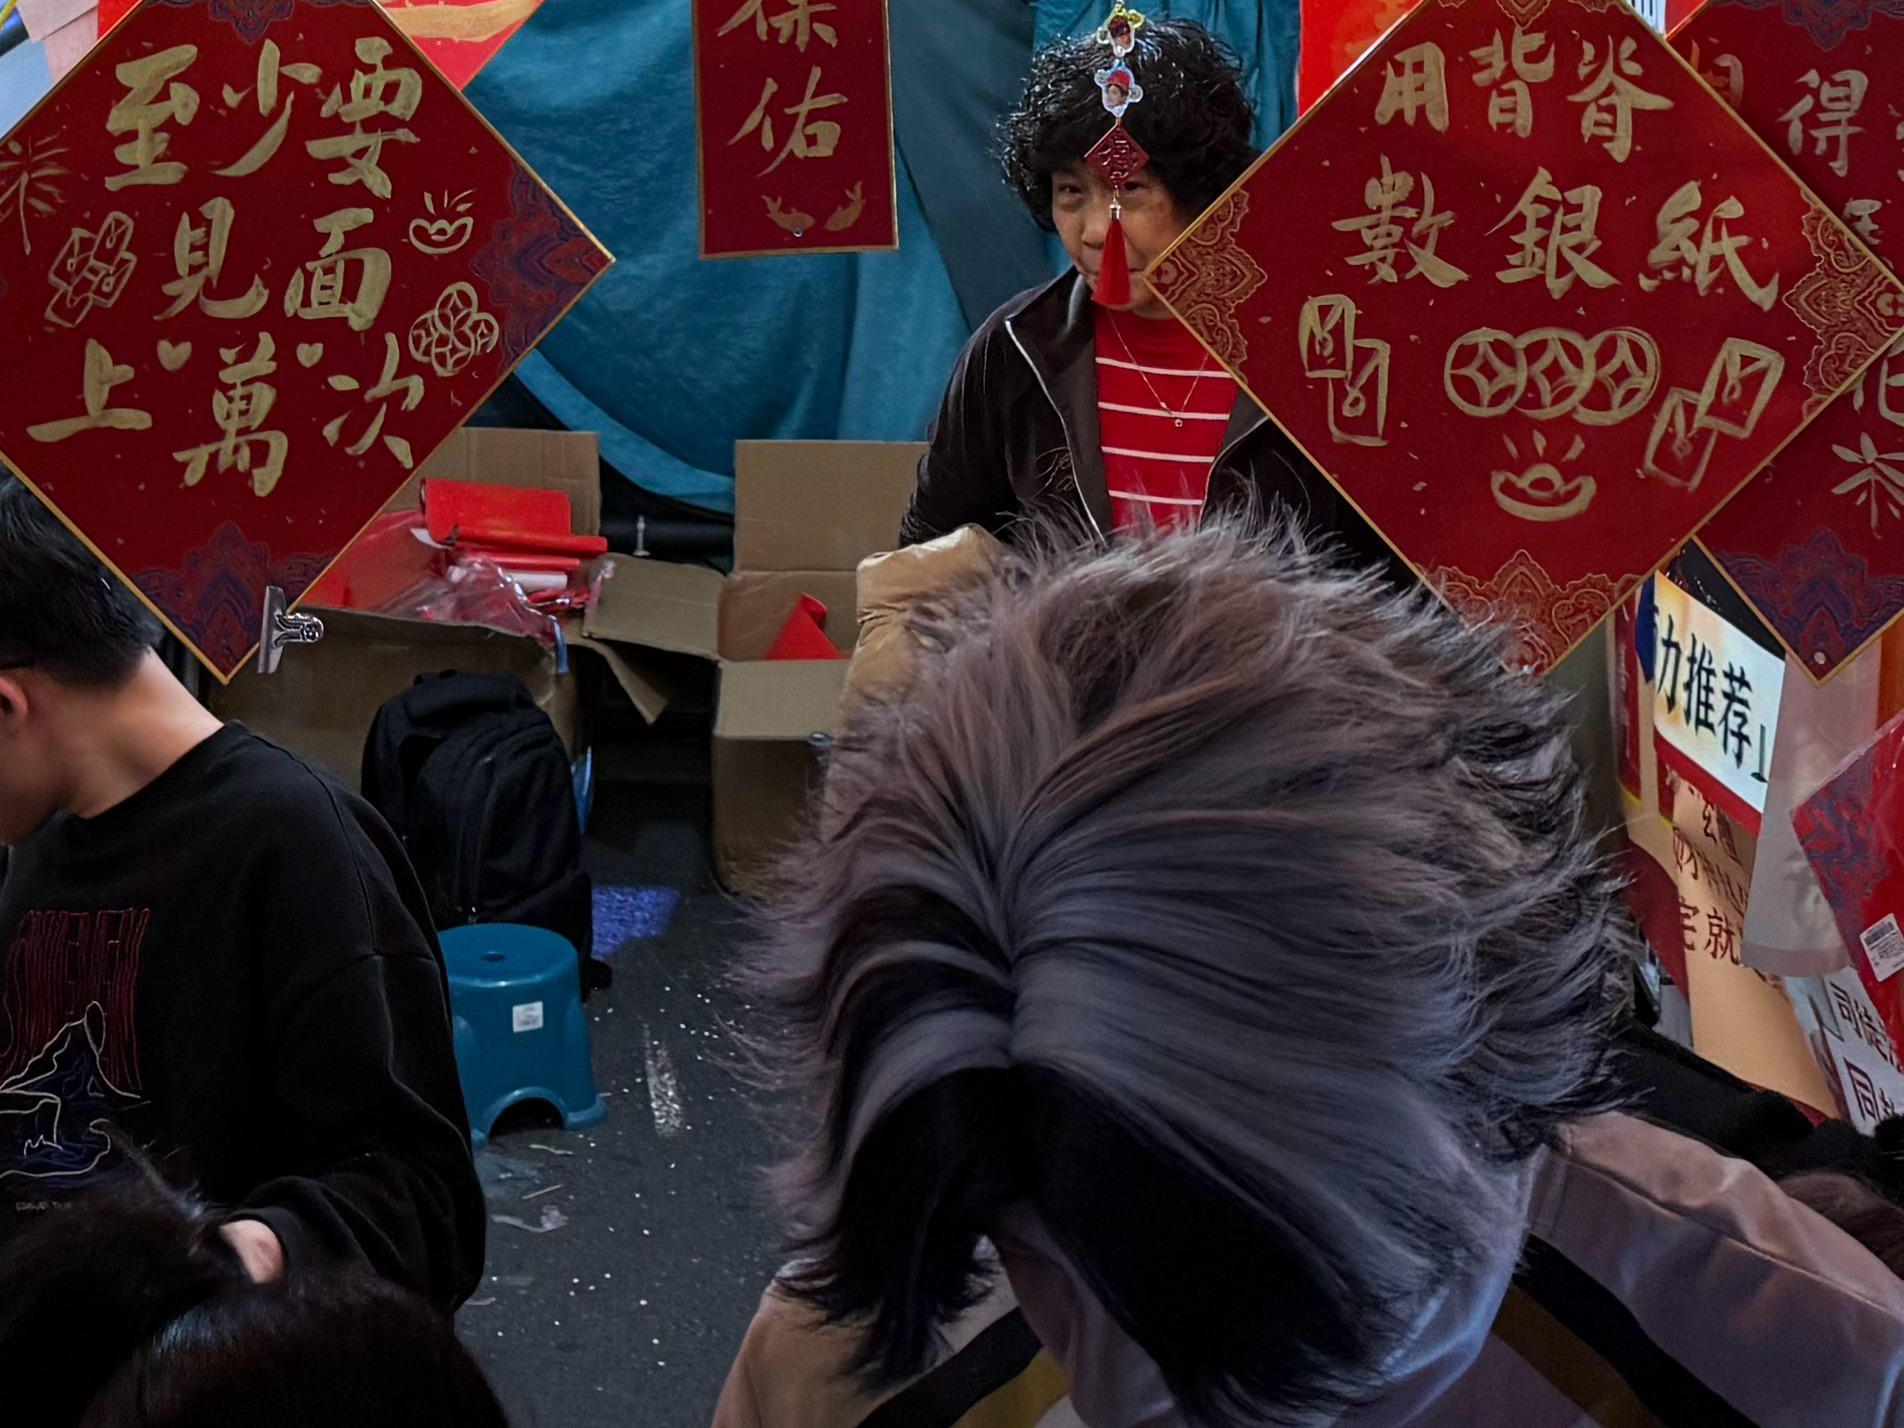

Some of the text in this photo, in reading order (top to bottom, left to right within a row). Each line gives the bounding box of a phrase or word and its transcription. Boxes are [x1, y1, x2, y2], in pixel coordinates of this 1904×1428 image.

[105, 37, 423, 199] 至少要
[1374, 30, 1674, 162] 用背脊
[155, 197, 394, 331] 見面
[1332, 155, 1779, 311] 數銀紙
